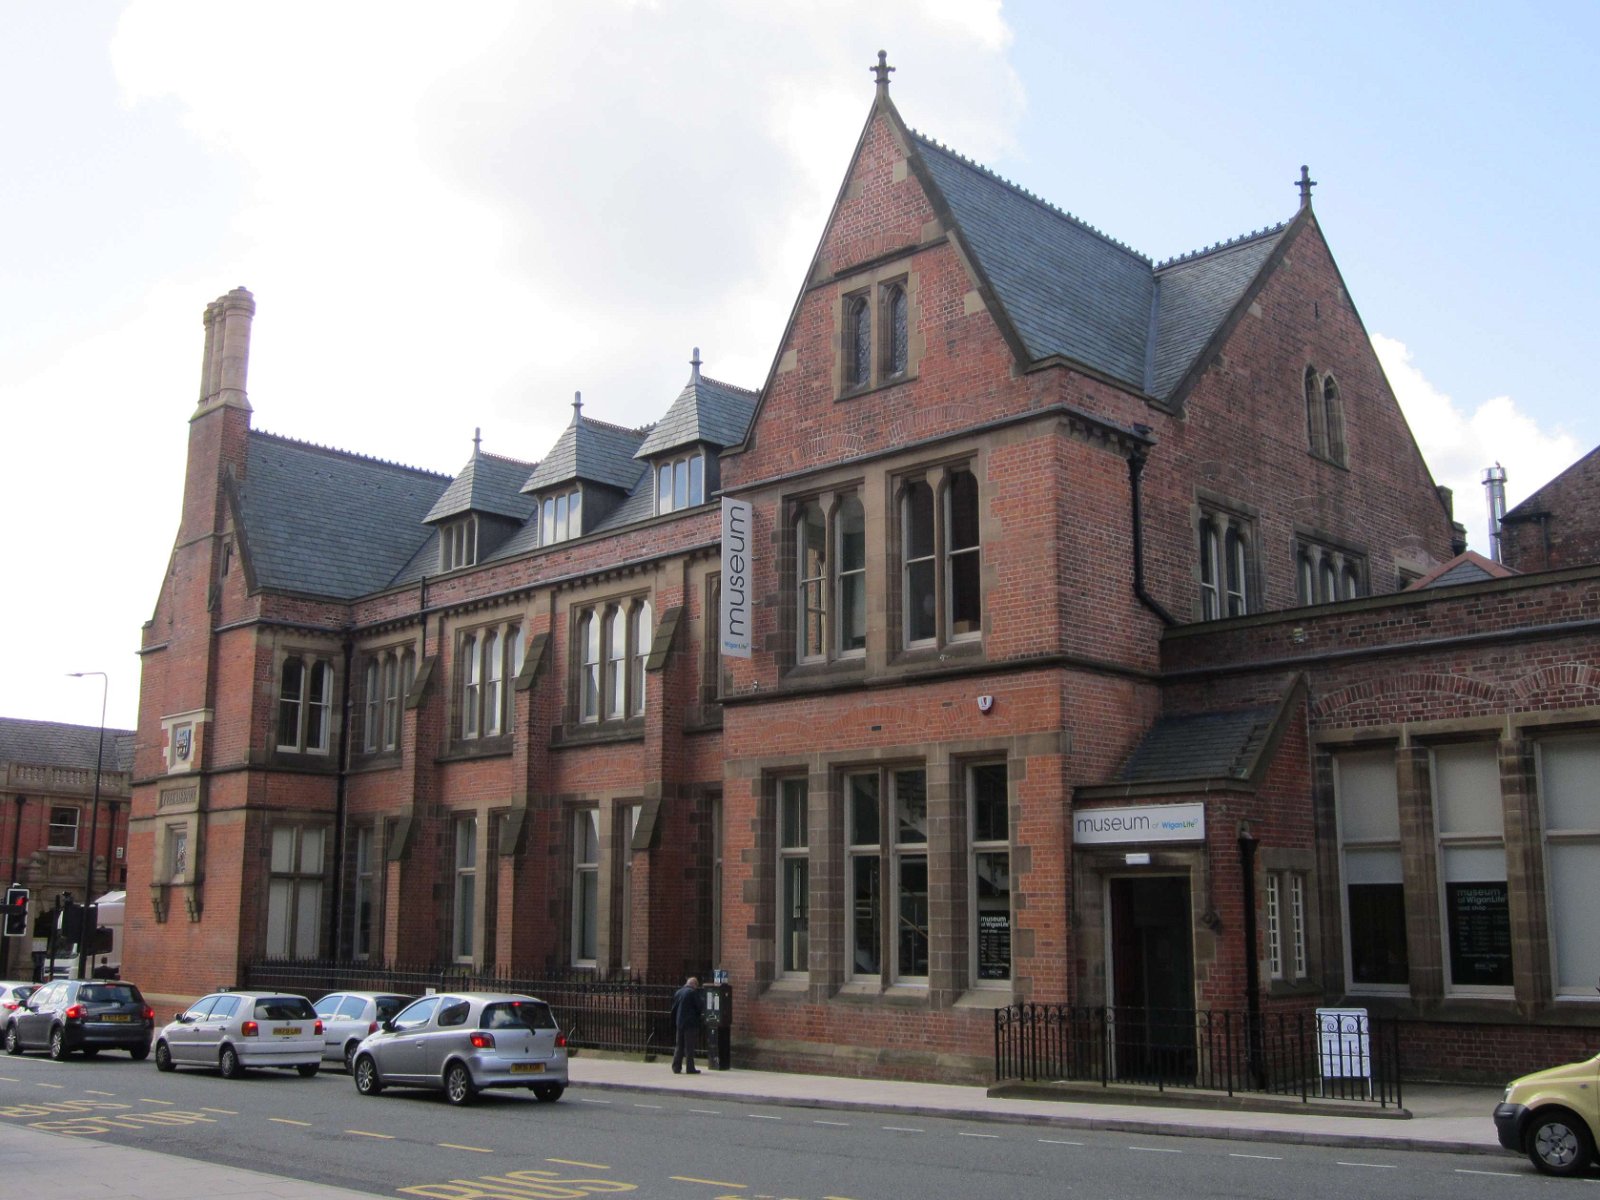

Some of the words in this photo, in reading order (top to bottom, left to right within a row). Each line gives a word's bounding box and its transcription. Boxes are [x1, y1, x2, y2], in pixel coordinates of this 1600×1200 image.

[730, 506, 745, 636] museum
[1077, 816, 1150, 832] museum
[1161, 820, 1195, 830] WiganLife
[0, 1100, 133, 1117] BUS
[28, 1111, 218, 1134] STOP
